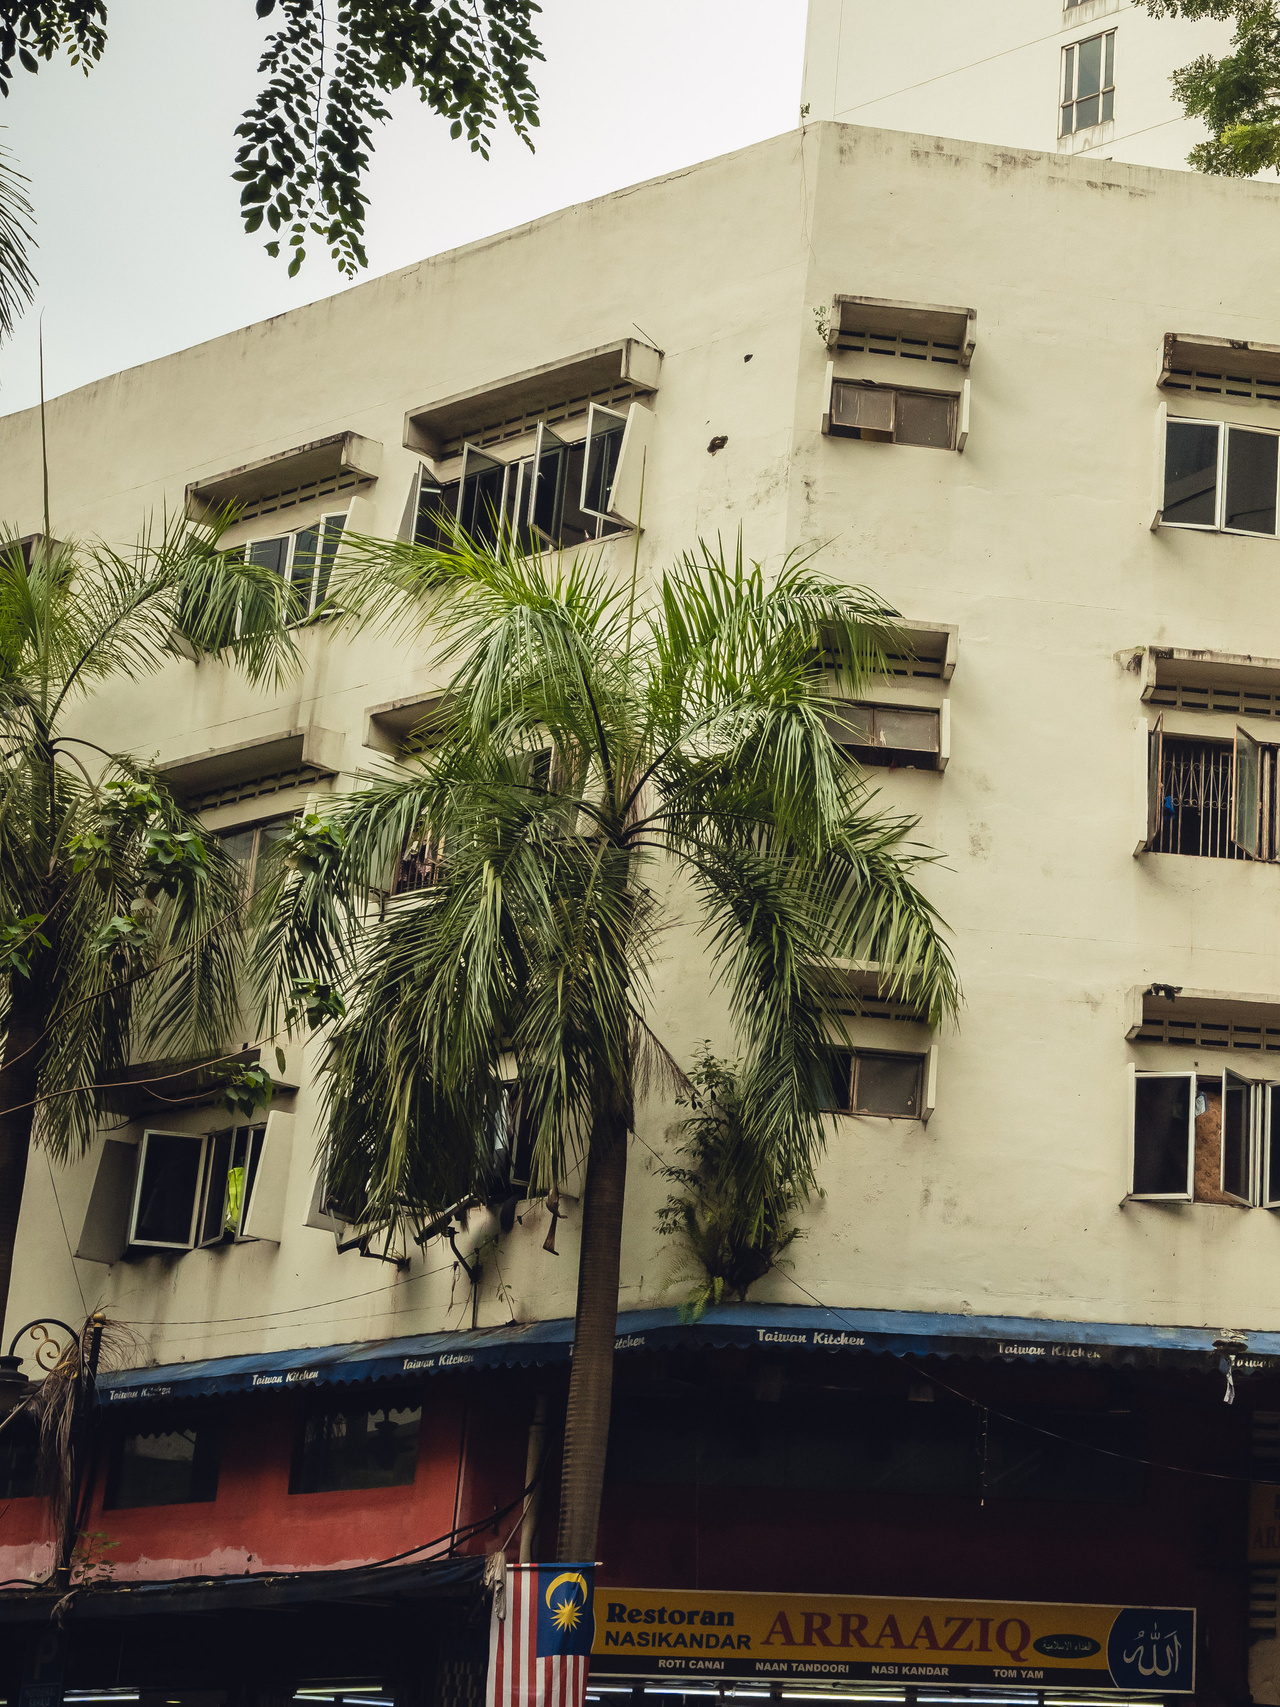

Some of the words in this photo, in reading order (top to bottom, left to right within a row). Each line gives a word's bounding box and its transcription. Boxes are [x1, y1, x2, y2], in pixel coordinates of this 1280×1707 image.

[614, 1335, 646, 1350] itchen
[756, 1328, 807, 1343] Taiwan
[812, 1331, 866, 1346] Kitchen
[997, 1341, 1046, 1356] Taiwan
[1051, 1345, 1102, 1359] Kitchen
[403, 1357, 435, 1370] Taiwan
[438, 1353, 475, 1367] Kitchen
[252, 1373, 283, 1386] Taiwan
[285, 1370, 320, 1382] Kitchen
[109, 1388, 138, 1400] Taiwan
[606, 1602, 735, 1627] Restoran
[605, 1630, 752, 1651] NASIKANDAR
[760, 1610, 1031, 1663] ARRAAZIQ
[658, 1659, 685, 1669] ROTI
[688, 1659, 725, 1670] CANAI
[755, 1661, 788, 1672] NAAN
[791, 1663, 850, 1673] TANDOORI
[871, 1665, 899, 1675] NASI
[901, 1666, 950, 1677] KANDAR
[992, 1668, 1017, 1678] TOM
[1020, 1669, 1044, 1679] YAM
